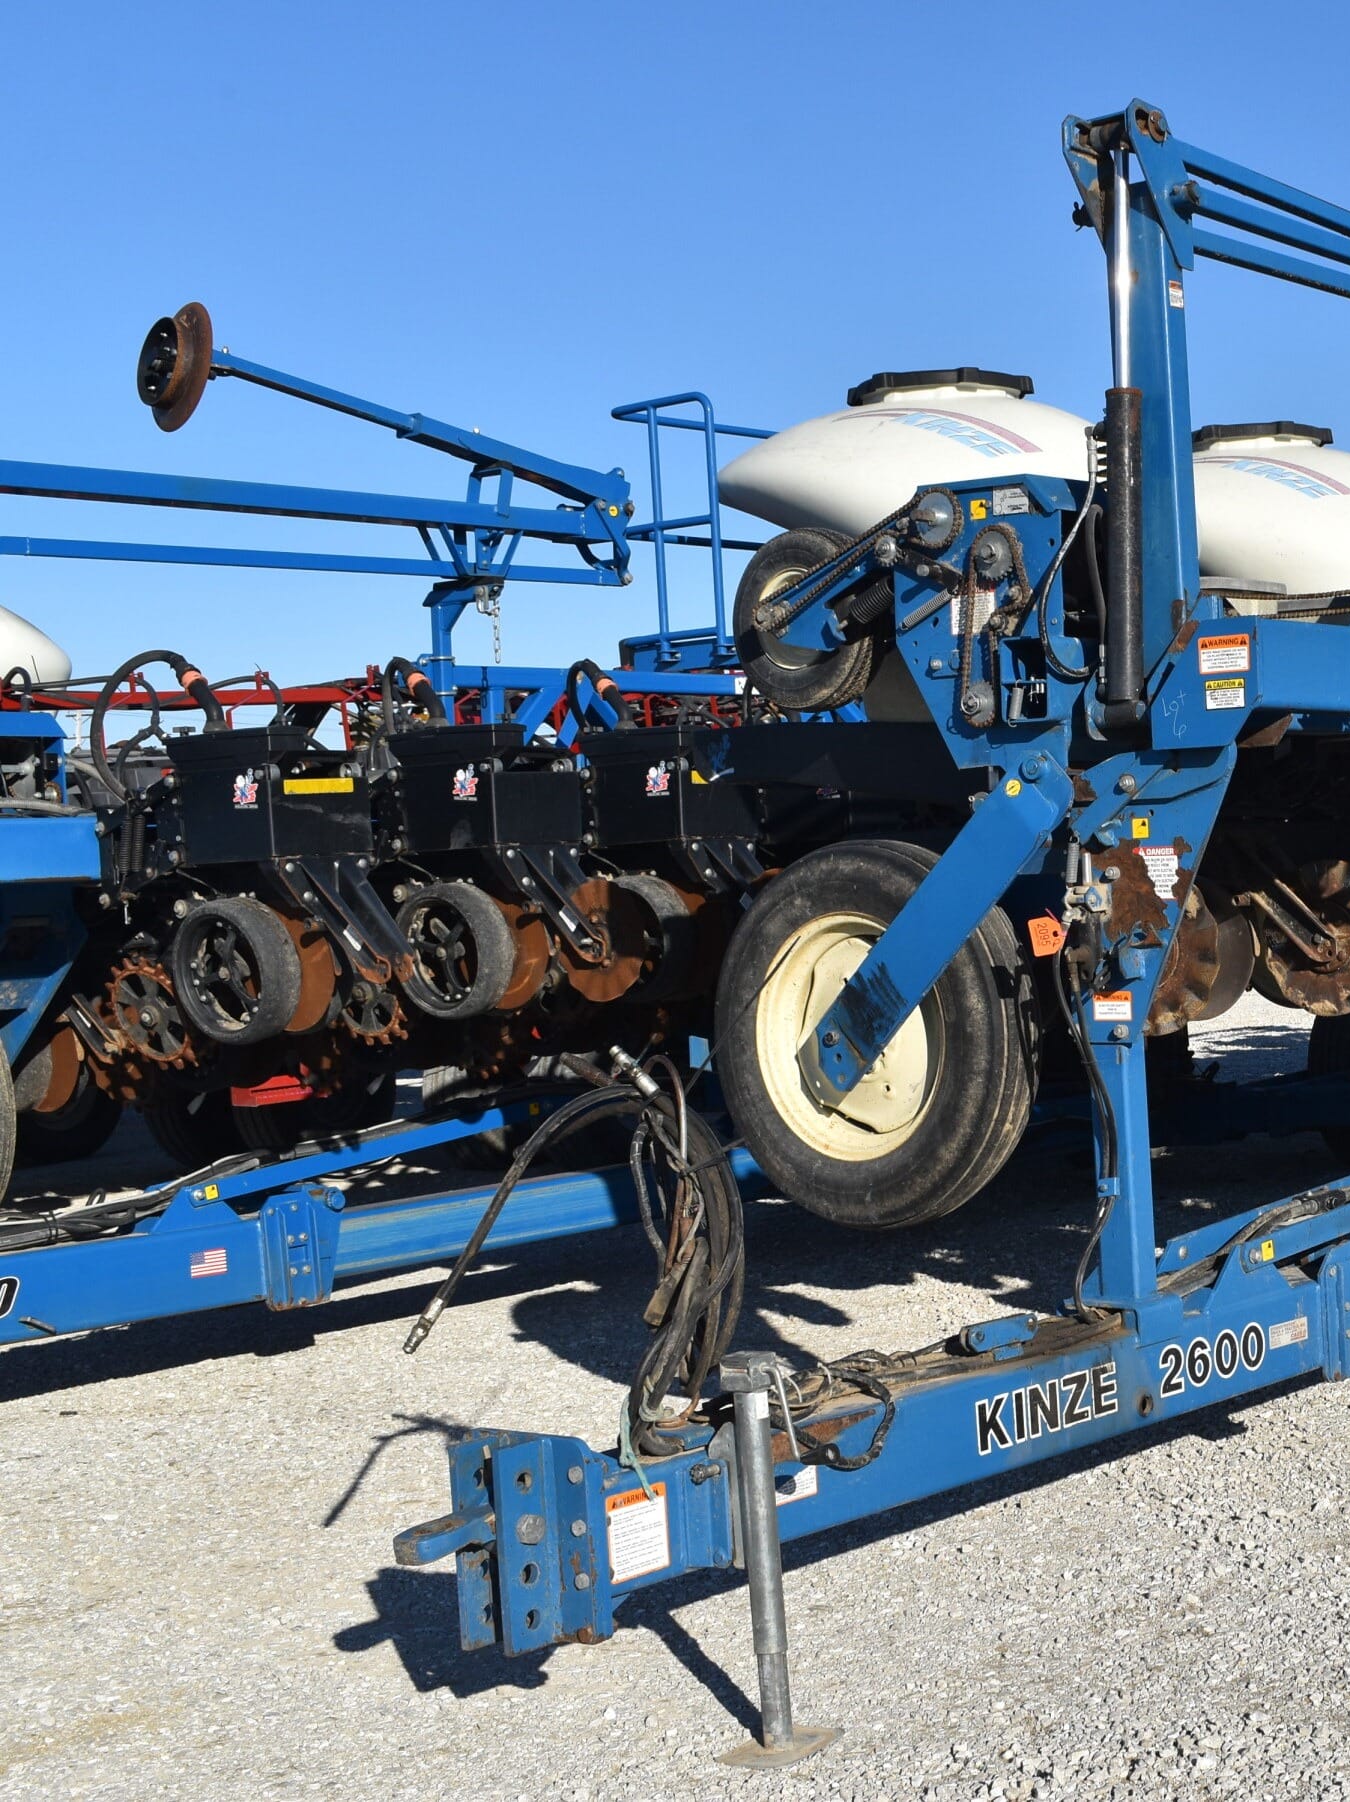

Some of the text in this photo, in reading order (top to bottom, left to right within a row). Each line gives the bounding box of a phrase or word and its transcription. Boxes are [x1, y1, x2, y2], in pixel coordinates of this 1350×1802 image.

[890, 411, 1021, 458] KINZE
[1222, 459, 1340, 499] KINZE
[1208, 637, 1239, 647] WARNING
[1212, 681, 1237, 689] CAUTION
[1146, 847, 1174, 856] DANGER
[1037, 922, 1051, 947] 2095
[975, 1321, 1266, 1456] KINZE 2600
